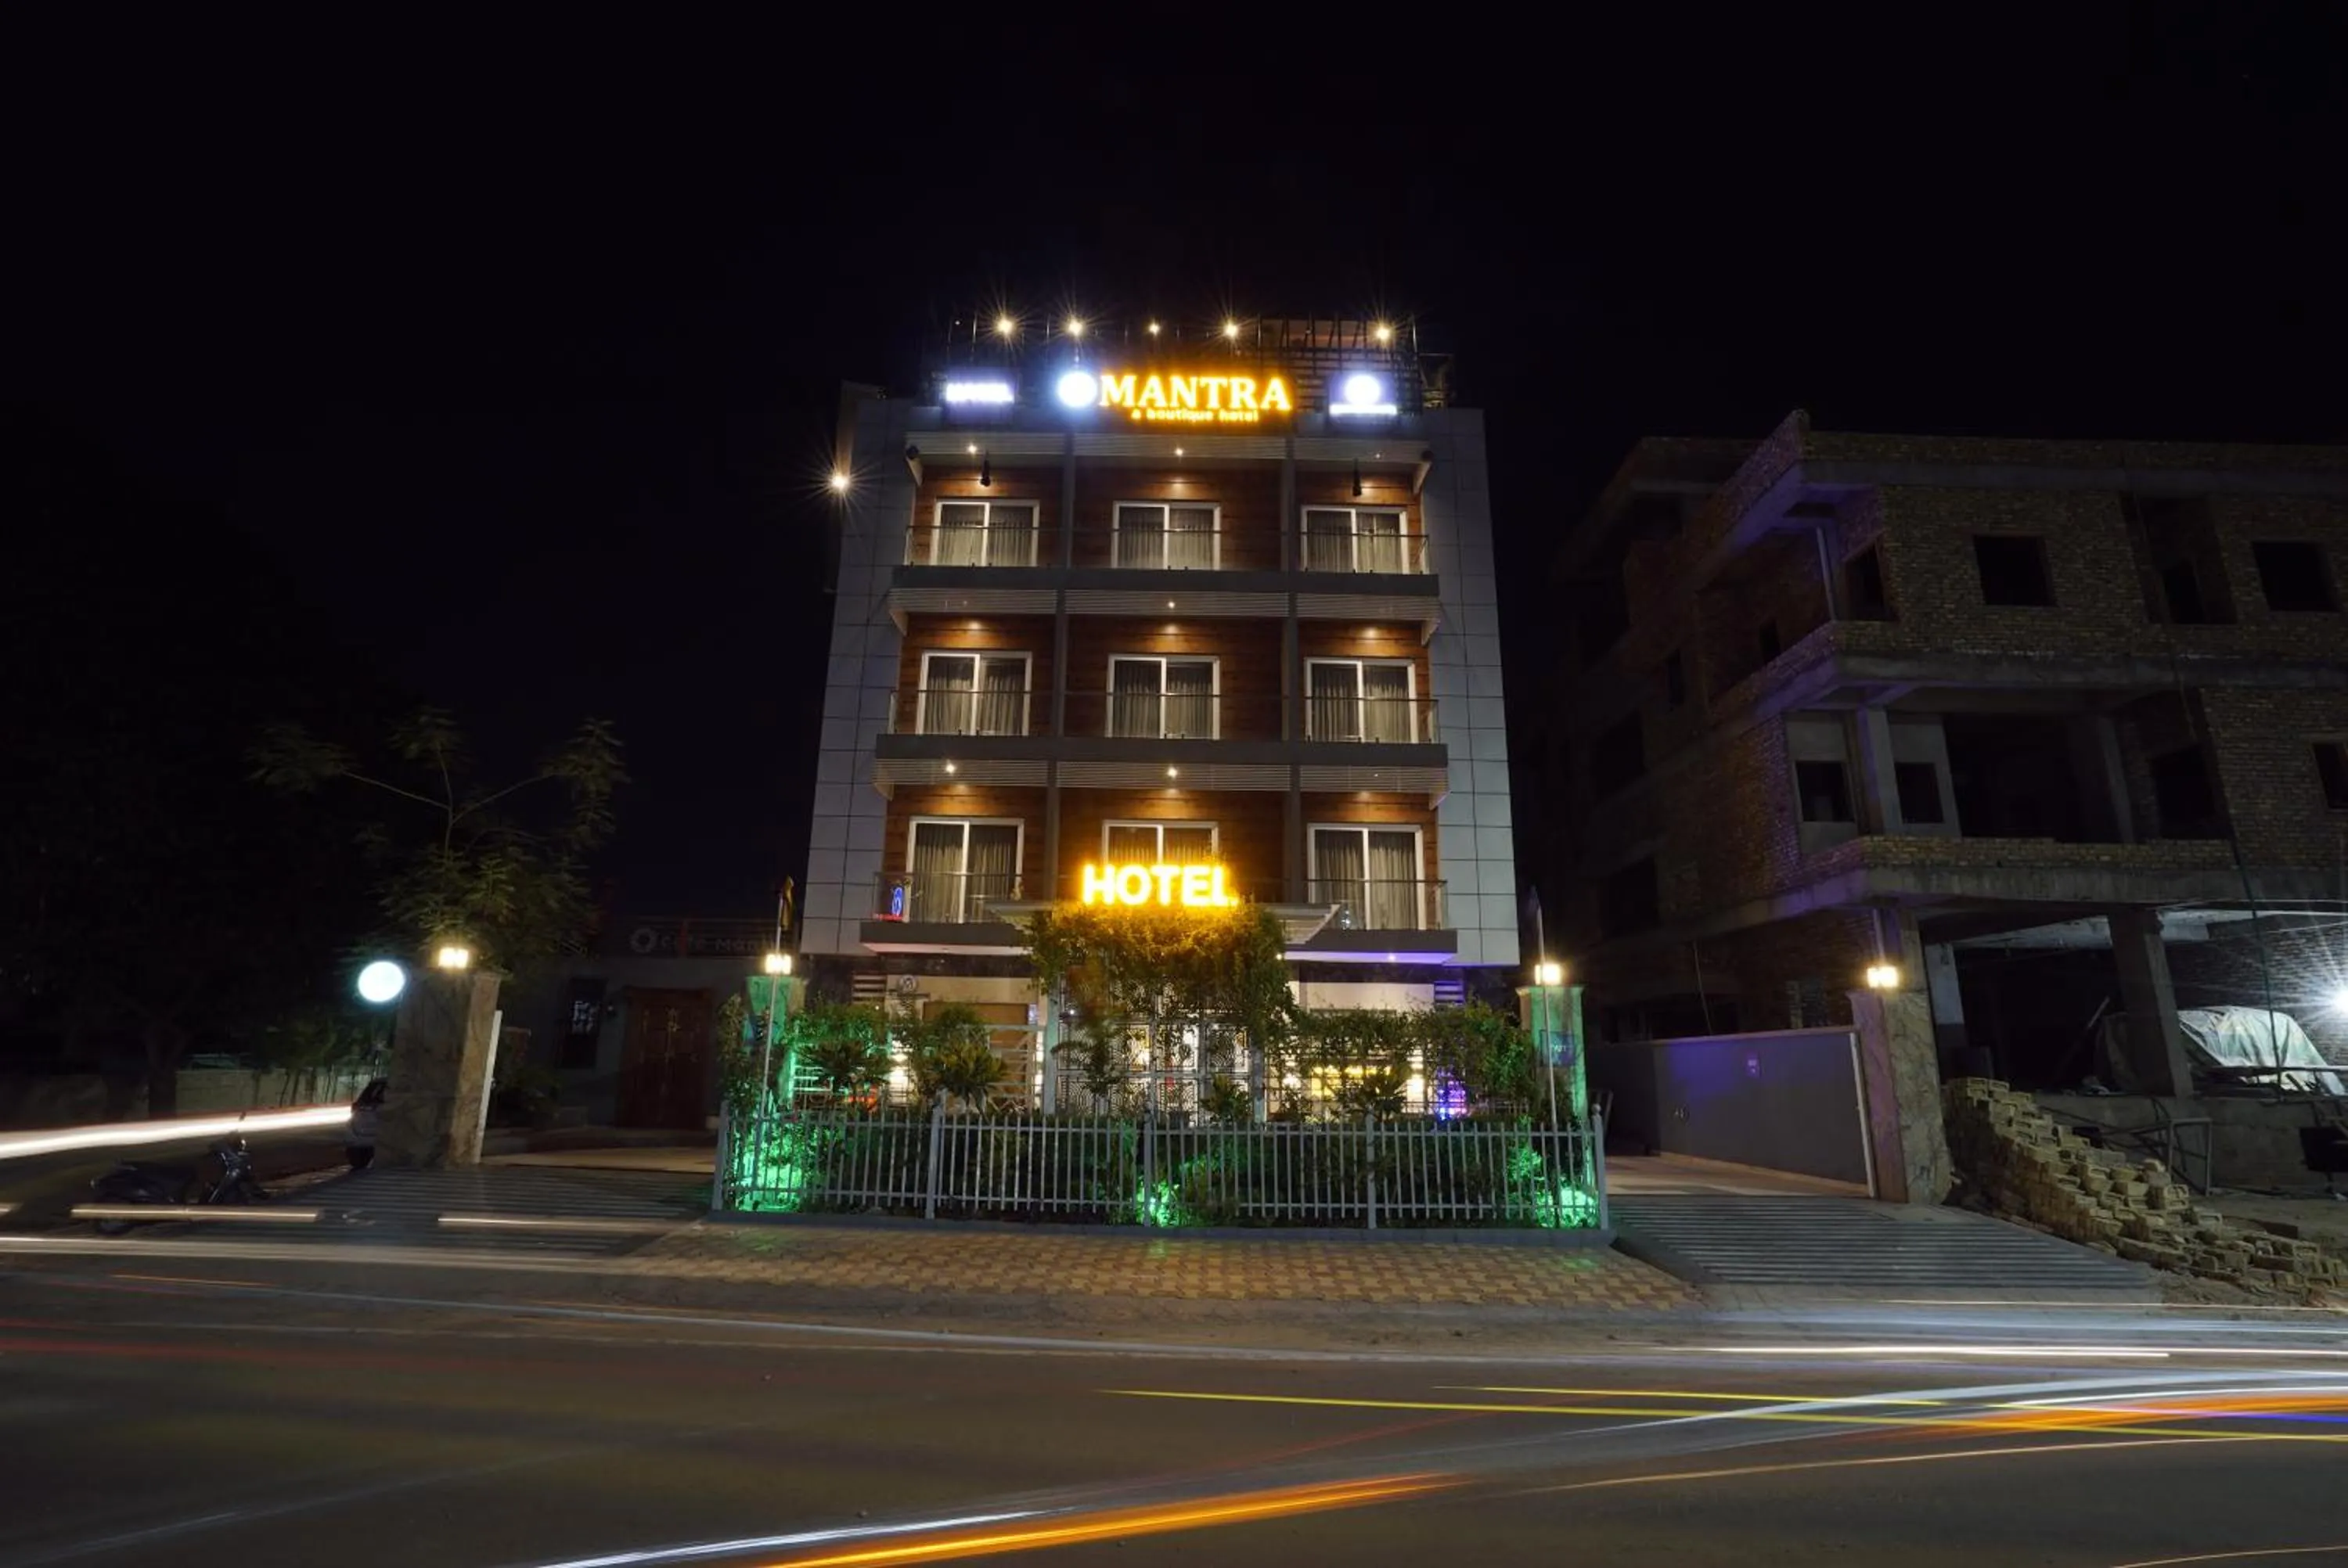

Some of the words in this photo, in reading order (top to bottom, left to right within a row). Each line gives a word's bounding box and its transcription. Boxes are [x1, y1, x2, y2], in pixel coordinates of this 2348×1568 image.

[1098, 374, 1293, 411] MANTRA
[1130, 408, 1142, 421] a
[1145, 408, 1214, 423] boutique
[1218, 408, 1260, 422] hotel
[1082, 863, 1235, 906] HOTEL
